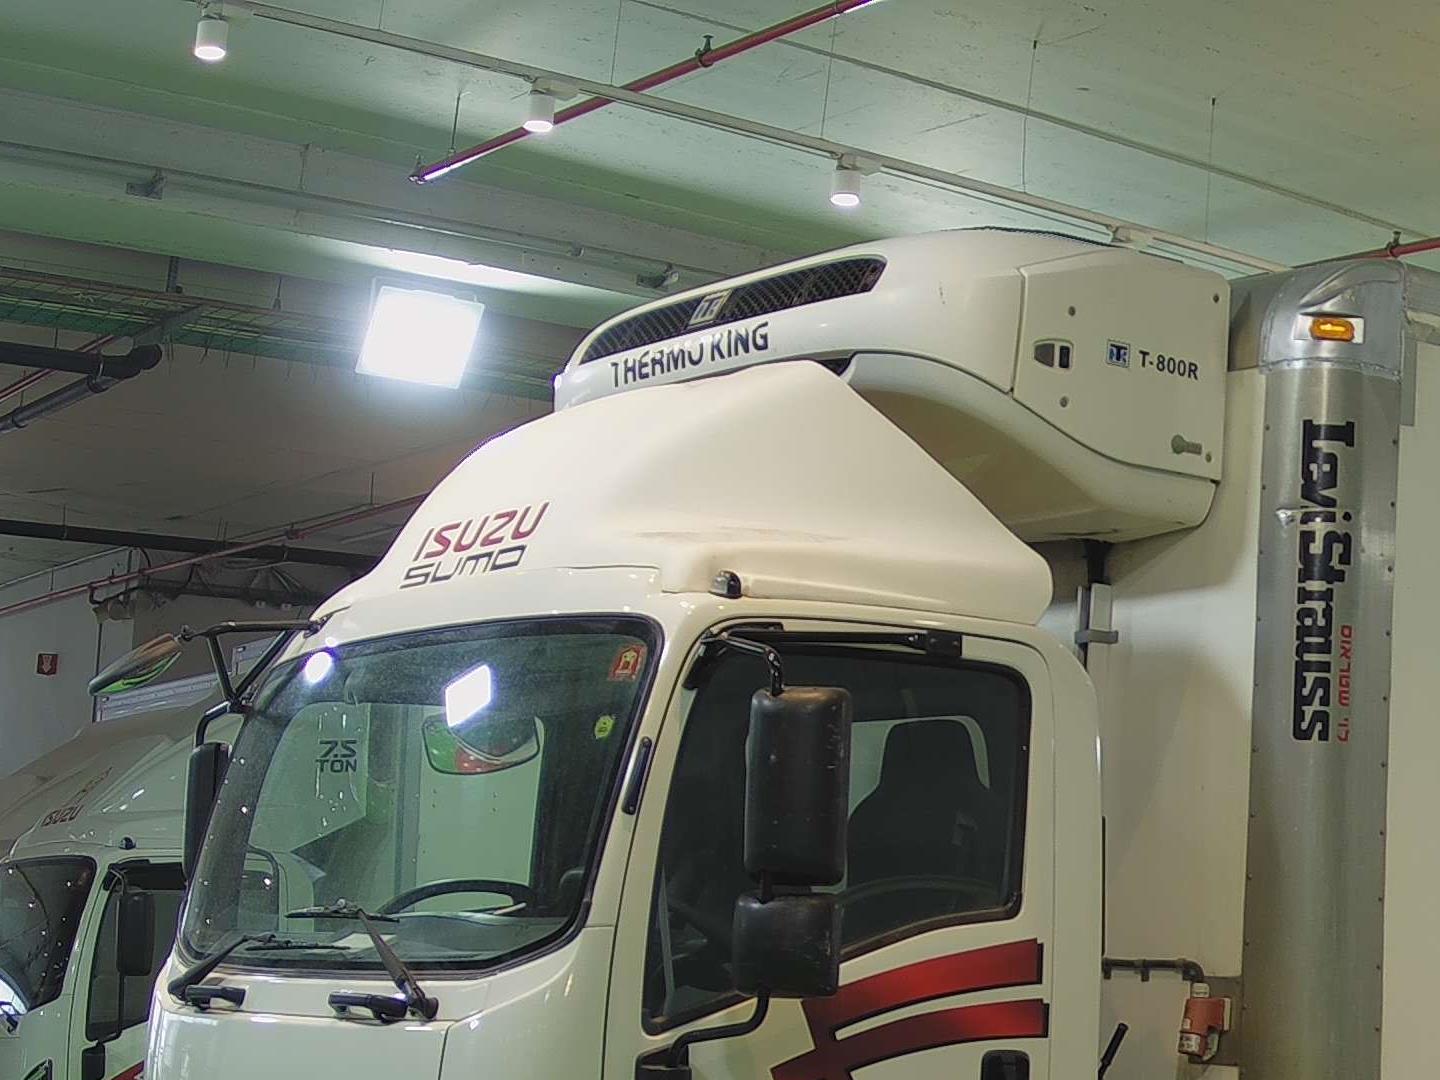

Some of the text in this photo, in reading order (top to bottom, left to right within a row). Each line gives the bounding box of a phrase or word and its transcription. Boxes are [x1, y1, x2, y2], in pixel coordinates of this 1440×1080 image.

[610, 321, 770, 388] THERMO KING
[1138, 349, 1199, 381] T-800R
[412, 501, 550, 562] ISUZU
[400, 544, 528, 590] SUMO
[315, 758, 358, 773] TON
[319, 739, 357, 759] 7.5
